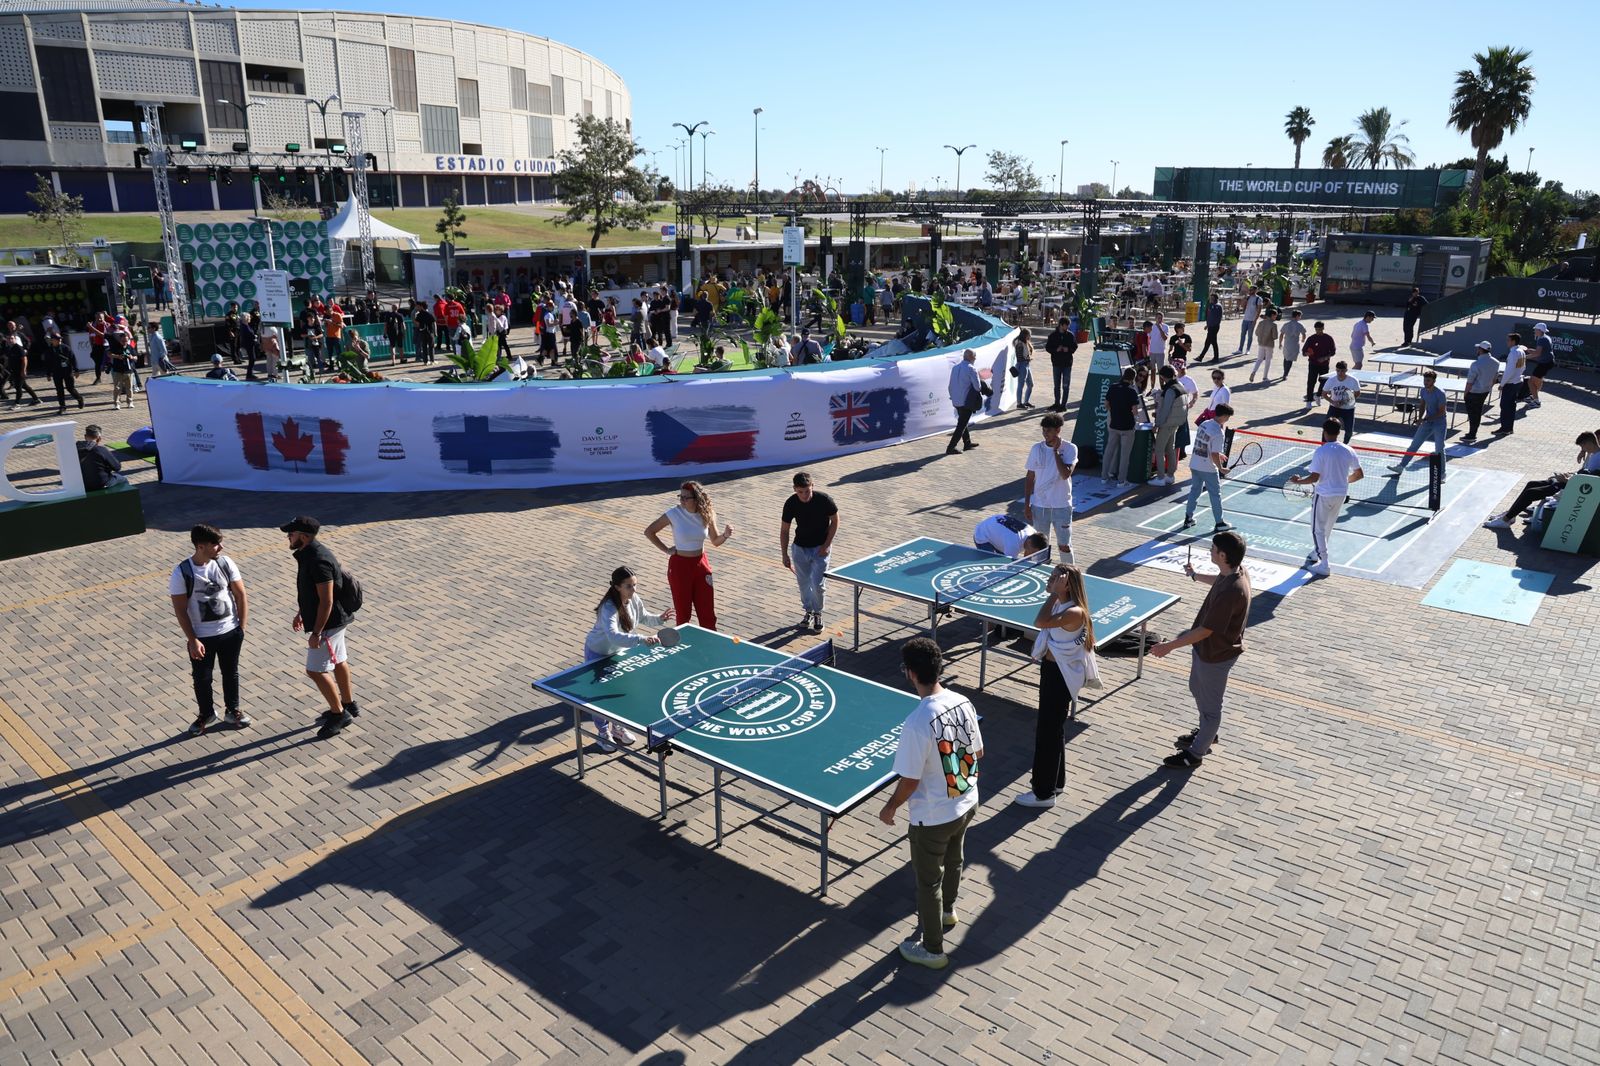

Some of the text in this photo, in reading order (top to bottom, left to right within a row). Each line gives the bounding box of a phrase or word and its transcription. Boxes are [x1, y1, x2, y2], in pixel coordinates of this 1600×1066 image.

[435, 156, 557, 173] ESTADIO CIUDAD
[1219, 179, 1400, 195] THE WORLD CUP OF TENNIS
[1547, 290, 1587, 299] DAVIS CUP
[1551, 343, 1573, 352] TENNIS
[1569, 338, 1584, 346] CUP
[1560, 496, 1586, 544] DAVIS CUP
[992, 595, 1039, 605] WORLD
[1090, 595, 1132, 619] WORLD CUP
[1097, 617, 1112, 625] OF
[1106, 603, 1137, 619] TENNIS
[599, 643, 692, 683] THE WORLD CUP
[603, 645, 666, 673] OF TENNIS
[672, 690, 691, 716] DAVIS
[684, 676, 709, 691] CUP
[694, 673, 826, 736] THE WORLD CUP OF TENNIS
[823, 721, 907, 775] THE WORLD CU
[855, 738, 900, 770] OF TEN
